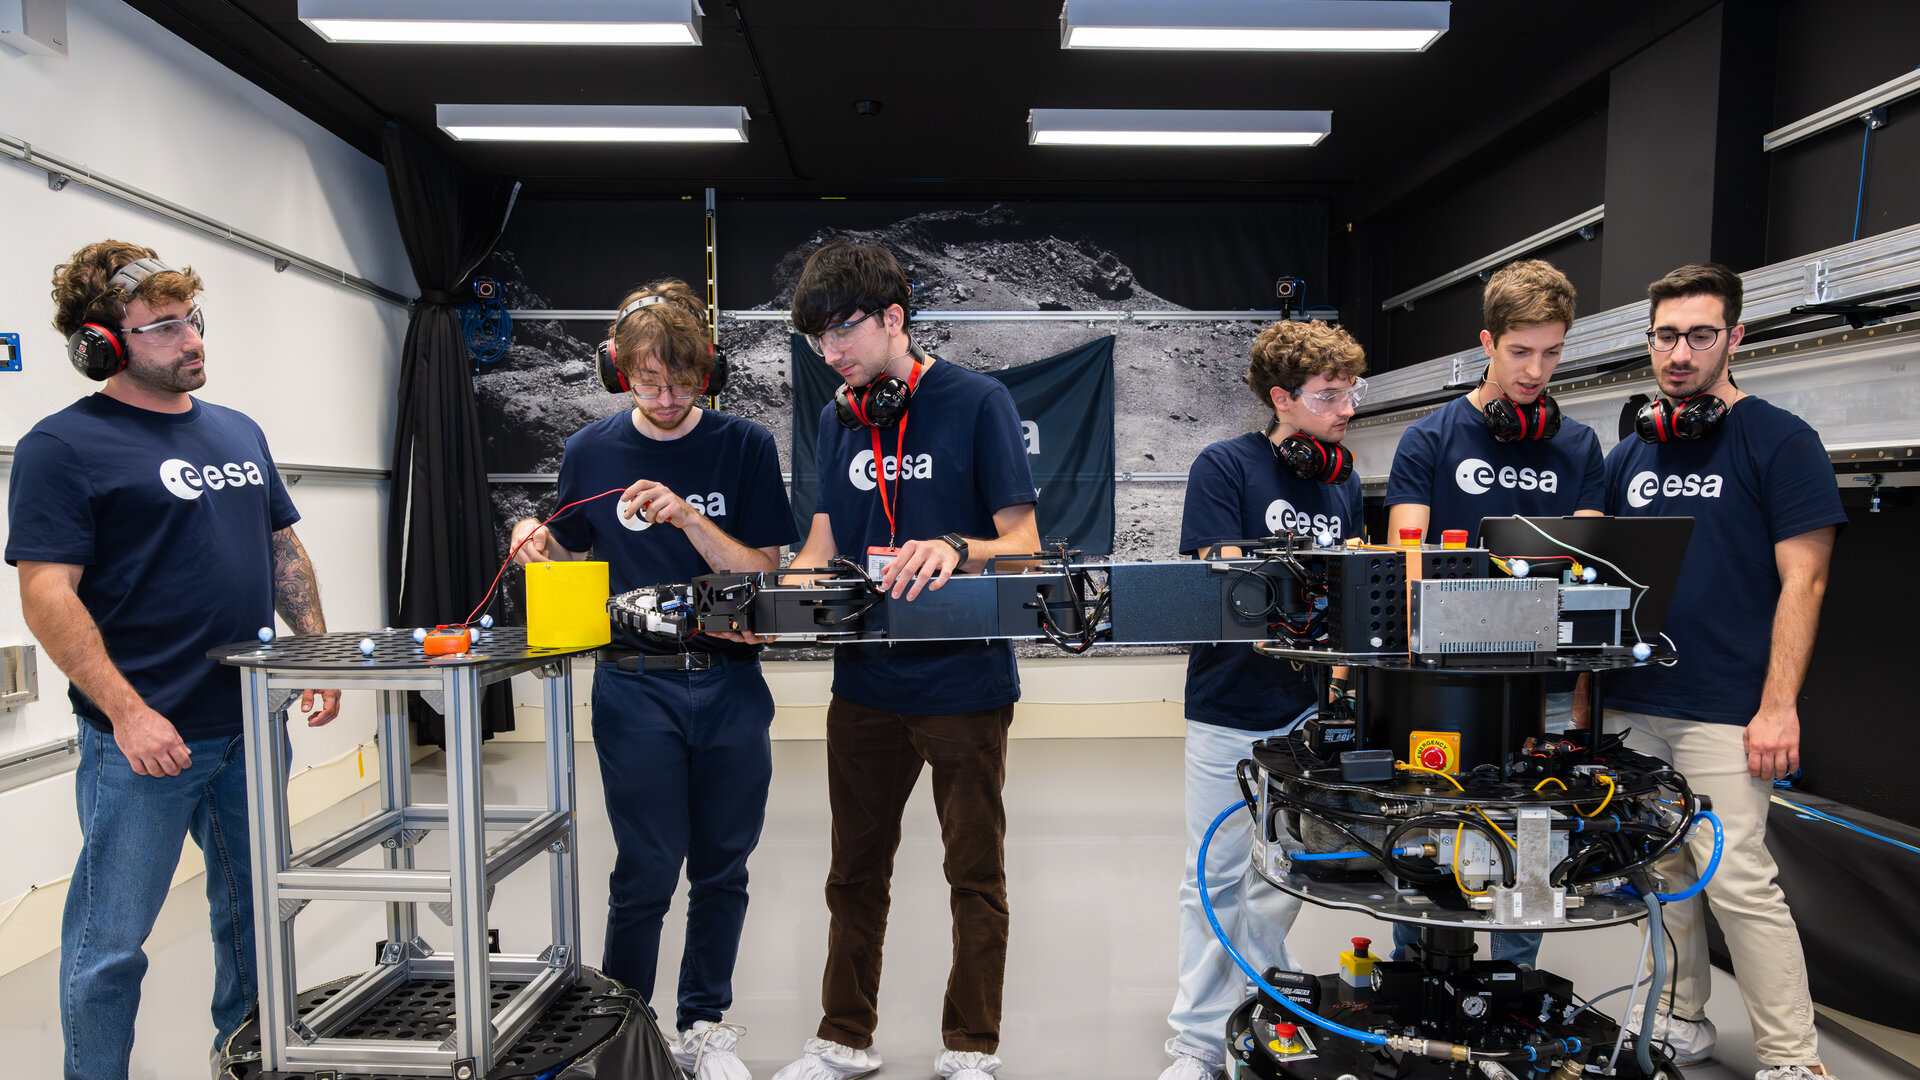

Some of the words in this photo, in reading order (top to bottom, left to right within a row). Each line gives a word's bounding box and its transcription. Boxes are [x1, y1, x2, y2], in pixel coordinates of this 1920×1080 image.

[203, 461, 264, 491] esa
[1498, 466, 1558, 494] esa
[1662, 474, 1724, 498] esa
[685, 491, 727, 516] sa
[1296, 511, 1342, 539] esa
[1417, 740, 1448, 759] EMERGENCY
